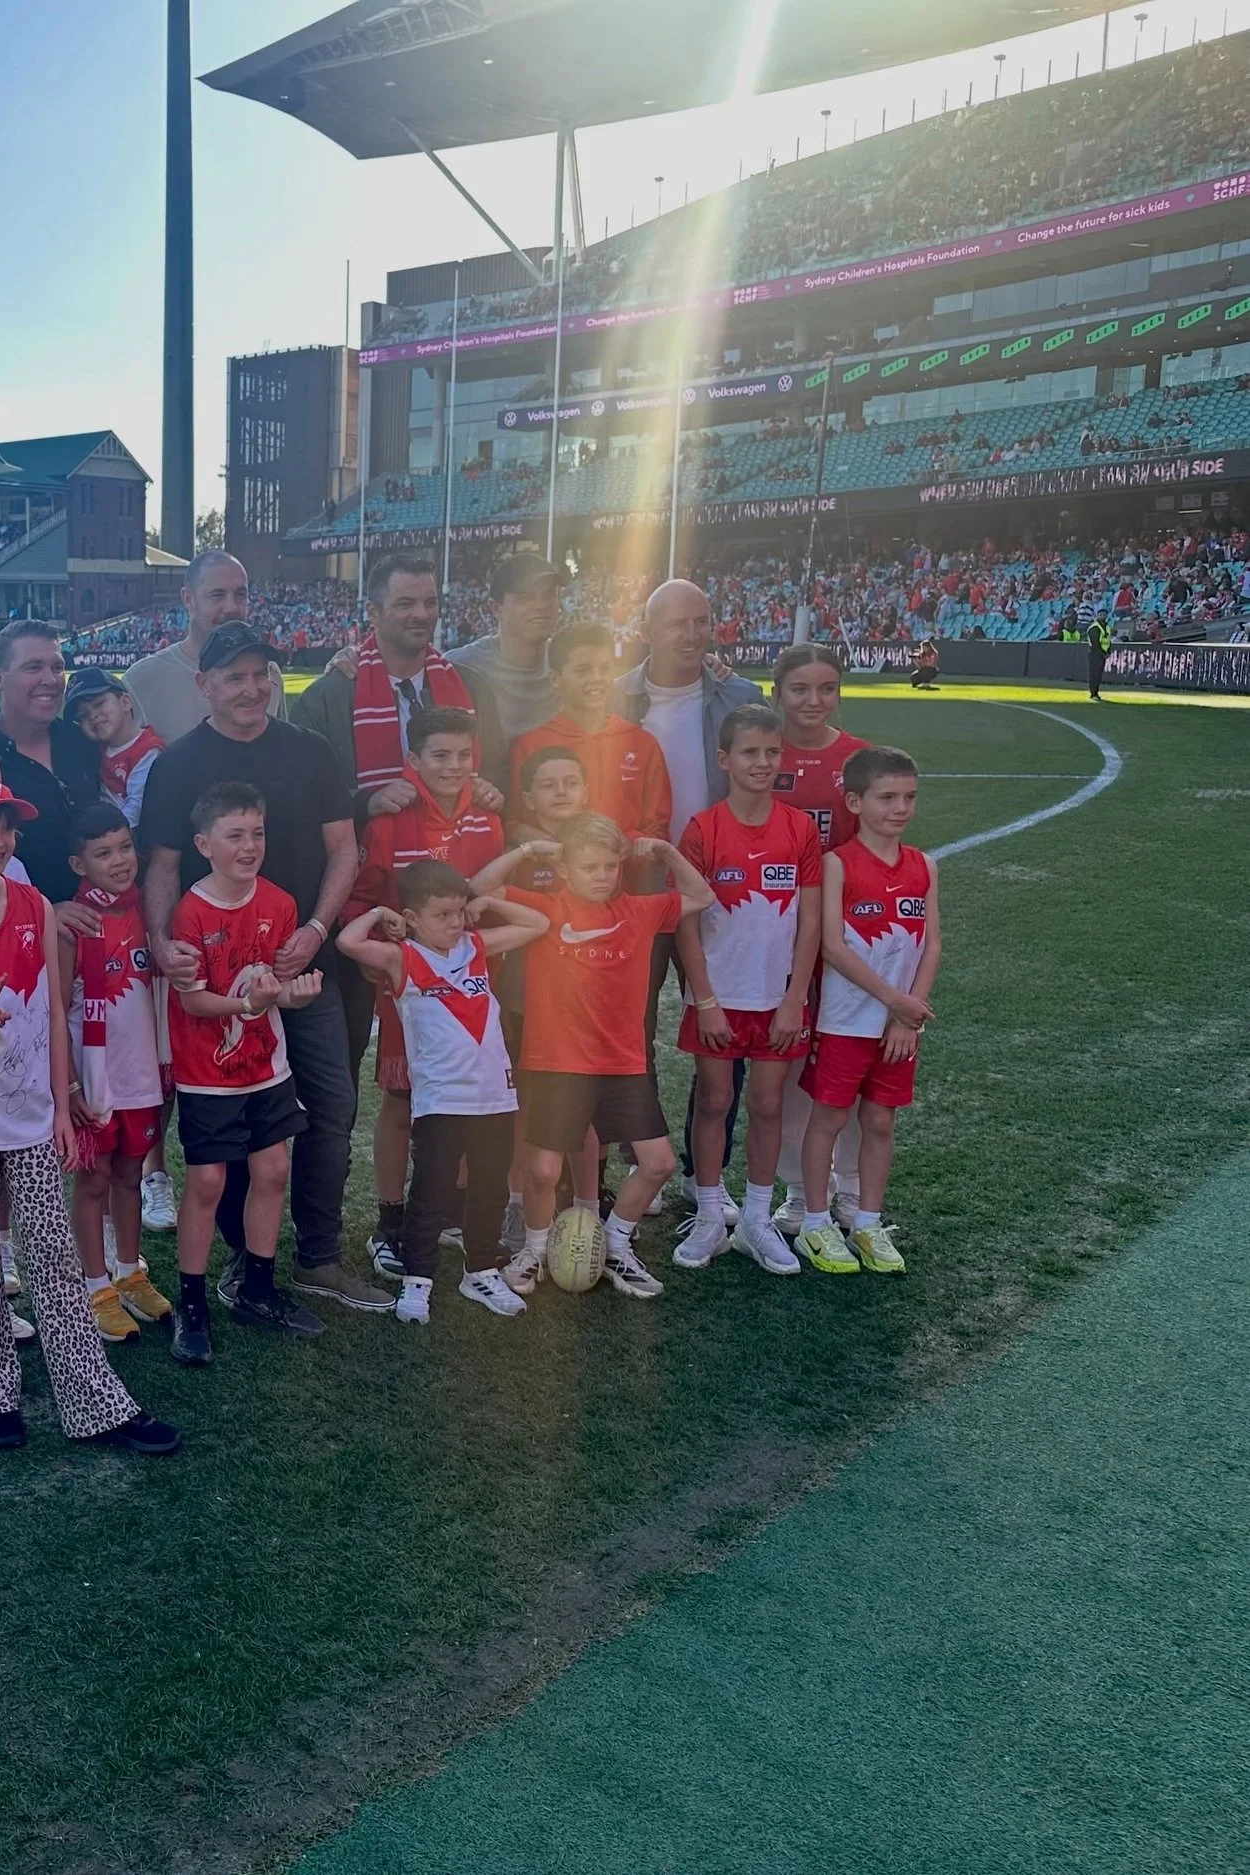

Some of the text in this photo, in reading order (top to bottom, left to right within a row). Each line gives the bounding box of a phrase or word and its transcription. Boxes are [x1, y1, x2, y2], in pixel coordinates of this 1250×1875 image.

[1213, 185, 1246, 200] SCHF
[1017, 198, 1170, 243] Change the future for sick kids
[803, 244, 980, 288] Sydney Children's Hospitals Foundation
[585, 314, 617, 328] Change
[416, 344, 443, 355] Sydney
[481, 332, 514, 344] Hospitals
[516, 325, 557, 338] Foundation
[708, 381, 766, 399] Volkswagen
[1192, 458, 1225, 475] SIDE
[500, 524, 523, 536] SIDE
[717, 870, 743, 881] AFL
[763, 865, 795, 881] QBE
[853, 902, 883, 915] AFL
